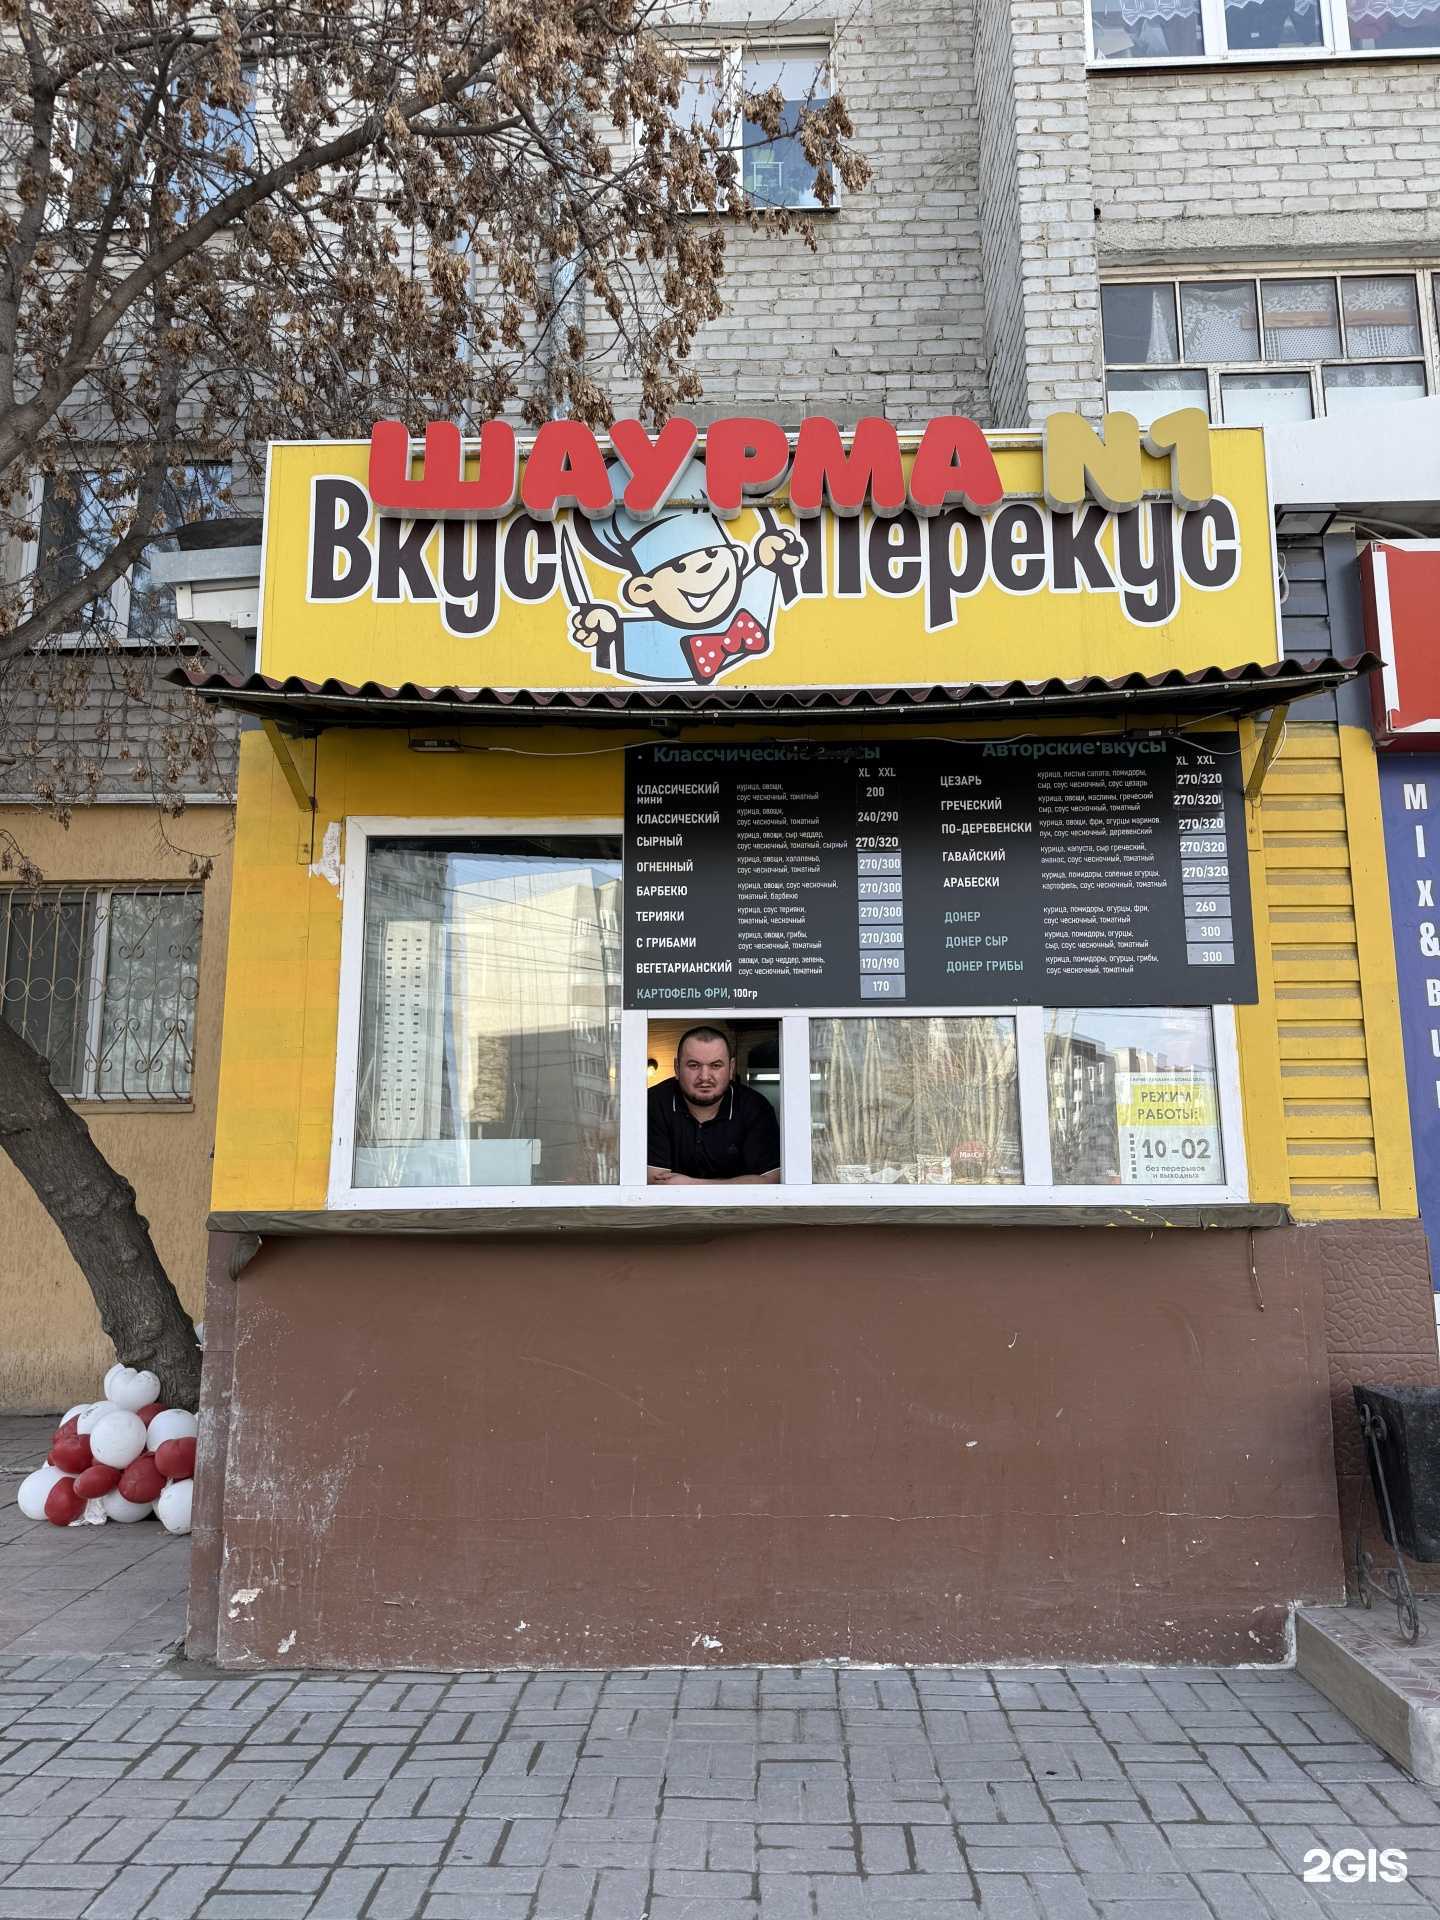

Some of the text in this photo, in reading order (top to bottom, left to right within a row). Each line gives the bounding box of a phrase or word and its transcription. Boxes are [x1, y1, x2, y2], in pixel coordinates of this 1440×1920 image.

[369, 416, 1003, 522] ШАУРМА
[311, 479, 557, 634] Вкус
[982, 741, 1167, 759] Авторские вкусы
[1176, 755, 1216, 766] XL XXL
[858, 767, 896, 777] XL XXL
[940, 776, 982, 788] ЦЕЗАРЬ
[1177, 772, 1223, 785] 270/320
[637, 781, 720, 794] КЛАССИЧЕСКИЙ
[866, 787, 885, 797] 200
[941, 797, 1002, 811] ГРЕЧЕСКИЙ
[637, 811, 720, 824] КЛАССИЧЕСКИЙ
[857, 811, 899, 824] 240/290
[941, 822, 1032, 835] ПО-ДЕРЕВЕНСКИ
[1179, 818, 1224, 830] 270/320
[636, 833, 683, 847] СЫРНЫЙ
[855, 836, 899, 848] 270/320
[1180, 841, 1225, 853] 270/320
[942, 848, 1006, 862] ГАВАЙСКИЙ
[636, 859, 694, 872] ОГНЕННЫЙ
[859, 858, 901, 870] 270/300
[1182, 865, 1228, 878] 270/320
[860, 882, 901, 894] 270/300
[943, 877, 1000, 888] АРАБЕСКИ
[636, 886, 688, 896] БАРБЕКЮ
[860, 906, 902, 918] 270/300
[1195, 902, 1216, 913] 260
[636, 911, 685, 922] ТЕРИЯКИ
[944, 912, 981, 924] ДОНЕР
[1200, 926, 1221, 937] 300
[636, 937, 697, 948] С ГРИБАМИ
[861, 932, 903, 944] 270/300
[945, 936, 1008, 948] ДОНЕР СЫР
[1202, 951, 1223, 962] 300
[636, 960, 732, 974] ВЕГЕТАРИАНСКИЙ
[862, 958, 900, 970] 170/190
[946, 960, 1024, 973] ДОНЕР ГРИБЫ
[872, 980, 890, 992] 170
[637, 988, 701, 999] КАРТОФЕЛЬ
[734, 988, 758, 999] 100гр
